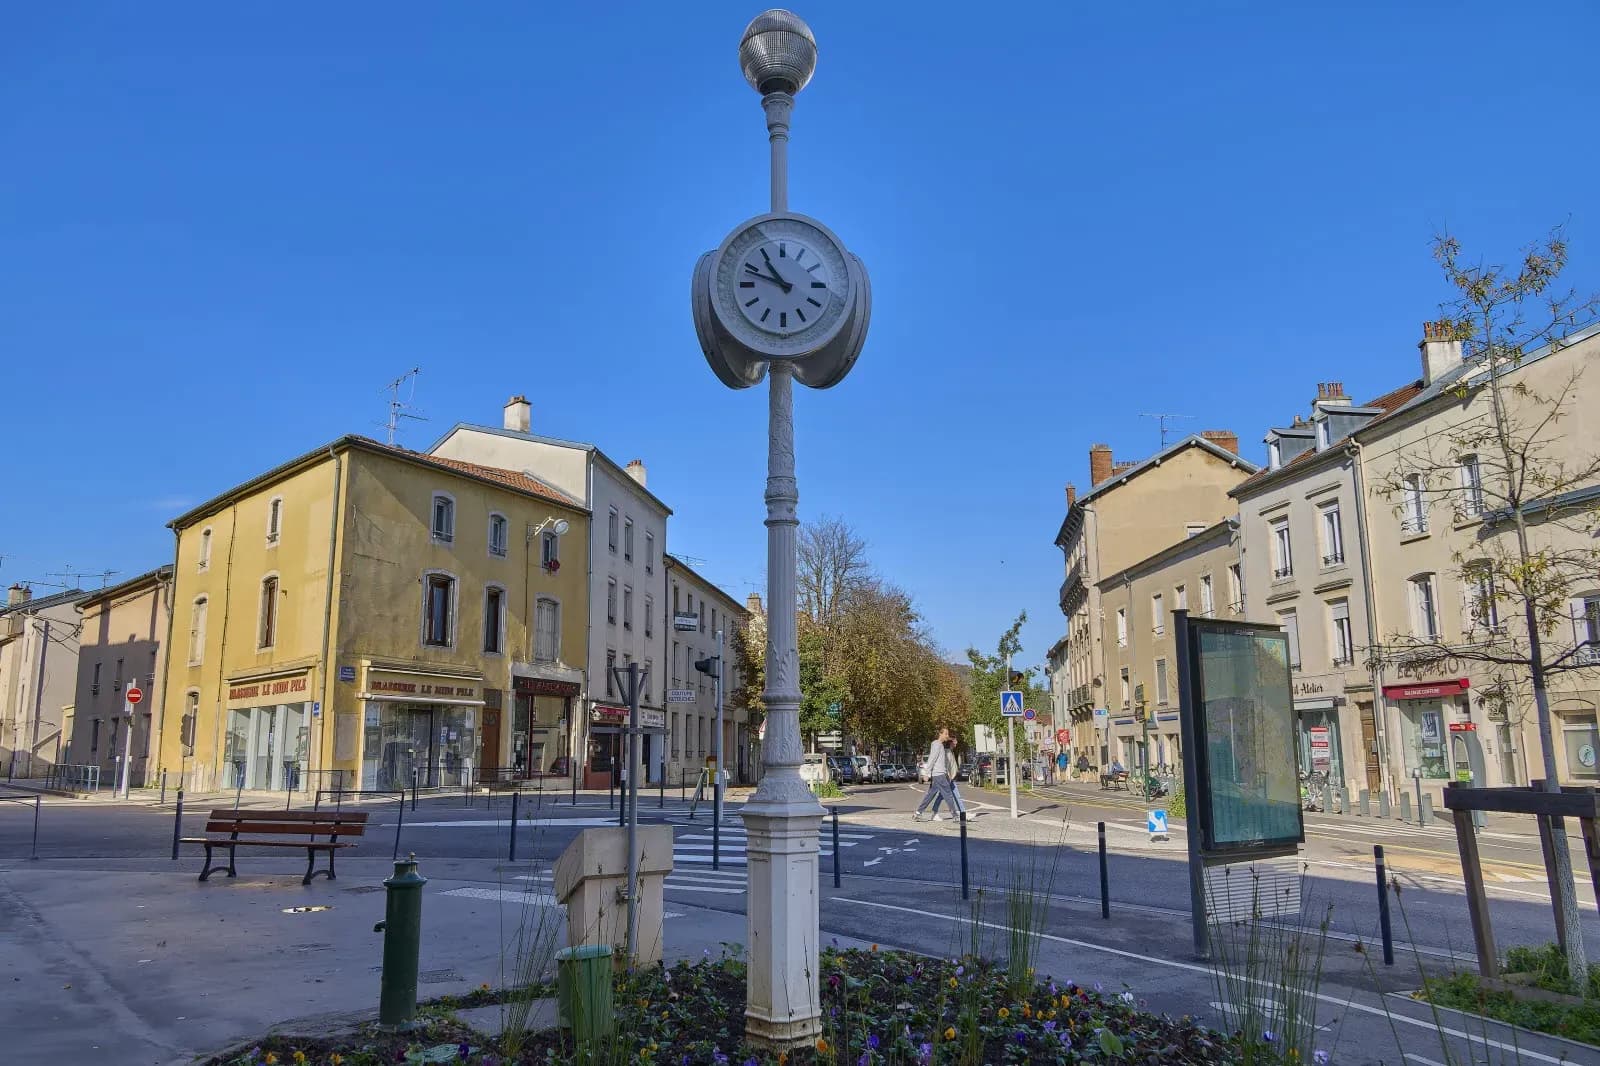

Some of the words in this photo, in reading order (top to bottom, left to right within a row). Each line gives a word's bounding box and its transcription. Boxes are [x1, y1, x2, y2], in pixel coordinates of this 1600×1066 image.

[262, 684, 270, 696] LE
[290, 678, 306, 692] PILE
[420, 685, 432, 694] LE
[456, 687, 474, 696] PILE
